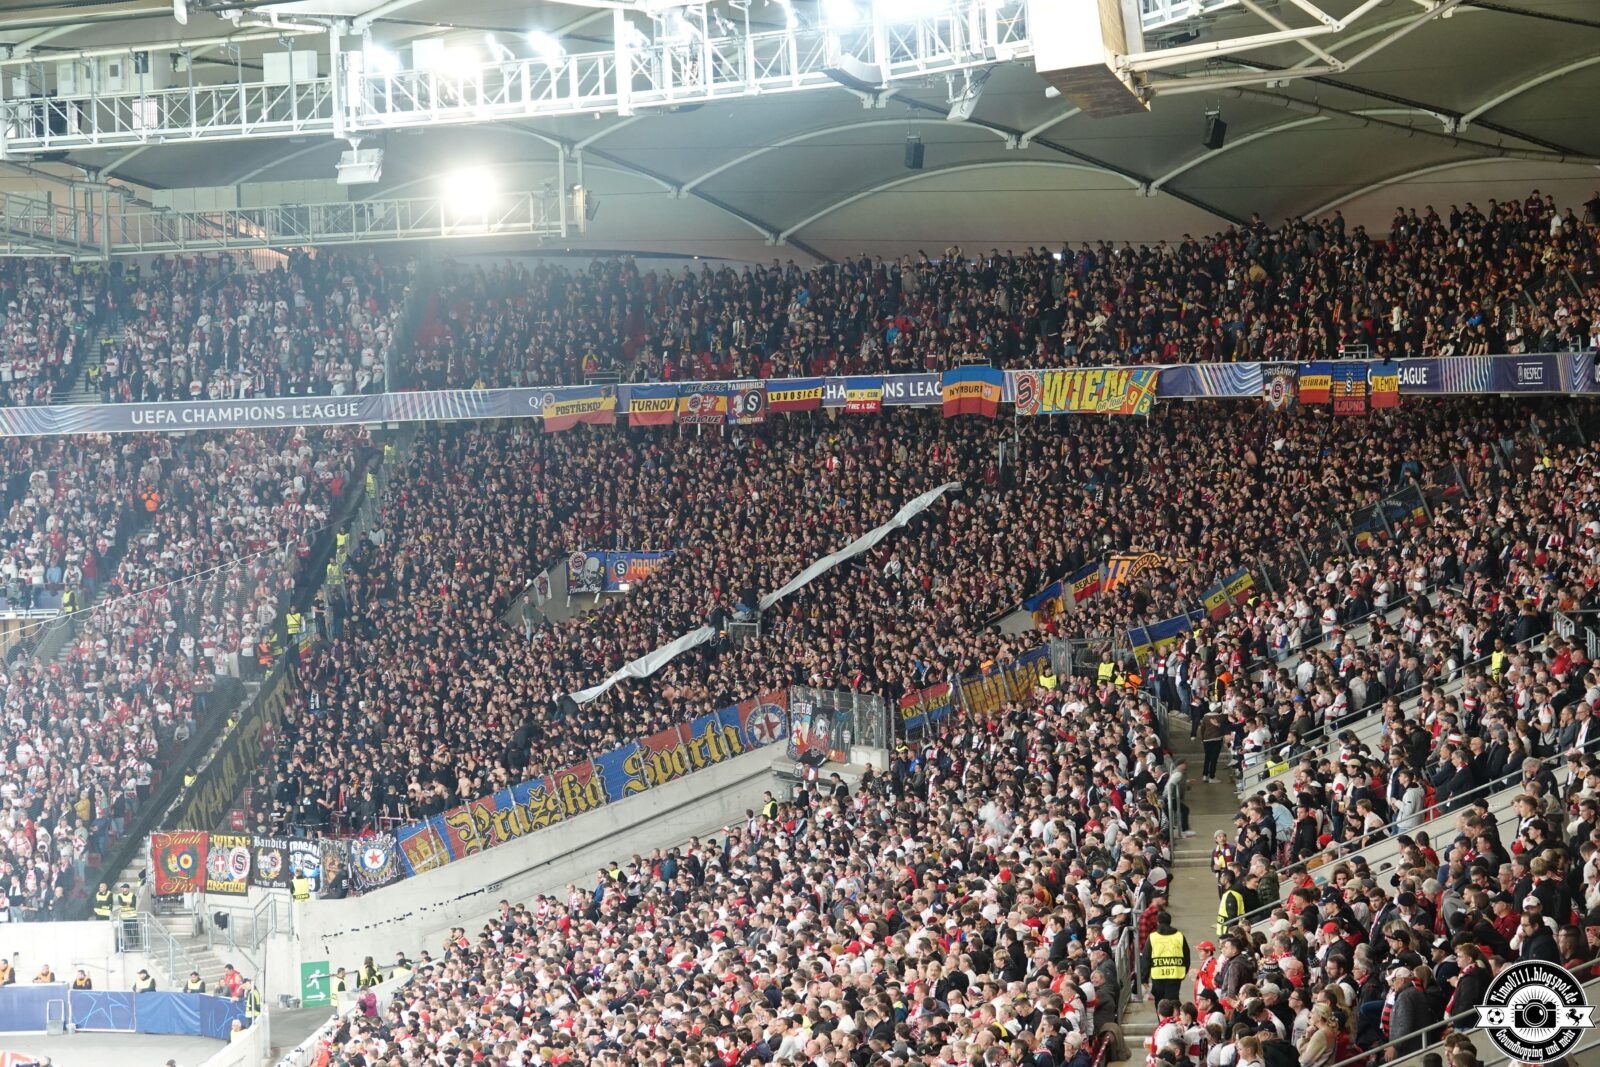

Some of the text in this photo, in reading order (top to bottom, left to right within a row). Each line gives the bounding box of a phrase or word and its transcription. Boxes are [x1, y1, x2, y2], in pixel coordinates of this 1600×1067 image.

[1523, 367, 1543, 380] RESPECT
[770, 389, 819, 401] LOVOSICE
[1042, 370, 1128, 411] WIEN
[631, 399, 673, 412] TURNOV
[131, 402, 360, 425] UEFA CHAMPIONS LEAGUE
[445, 720, 746, 857] Pražská Sparta
[213, 834, 246, 848] WIEN
[253, 835, 288, 849] Bandits
[1152, 958, 1183, 967] STEWARD
[1161, 968, 1175, 976] 187
